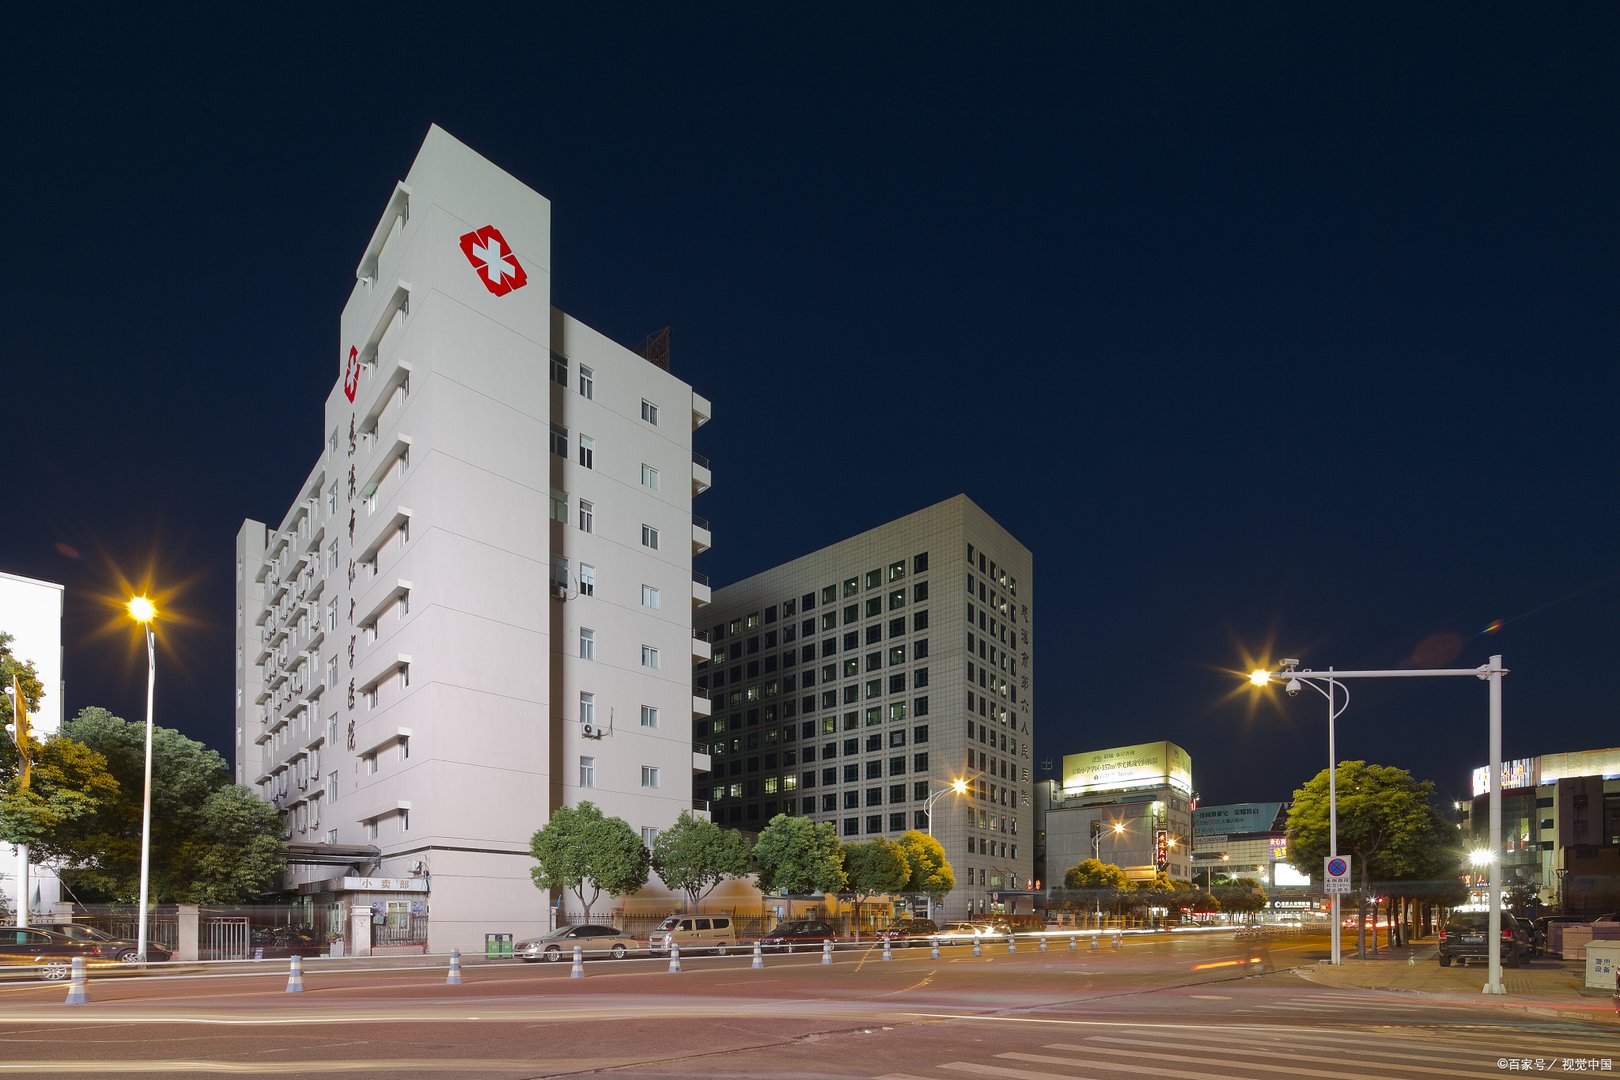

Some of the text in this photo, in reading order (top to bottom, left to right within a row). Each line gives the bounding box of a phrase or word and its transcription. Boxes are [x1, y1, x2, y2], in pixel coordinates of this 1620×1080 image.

[362, 879, 410, 889] 小卖部
[1594, 966, 1611, 974] 设备
